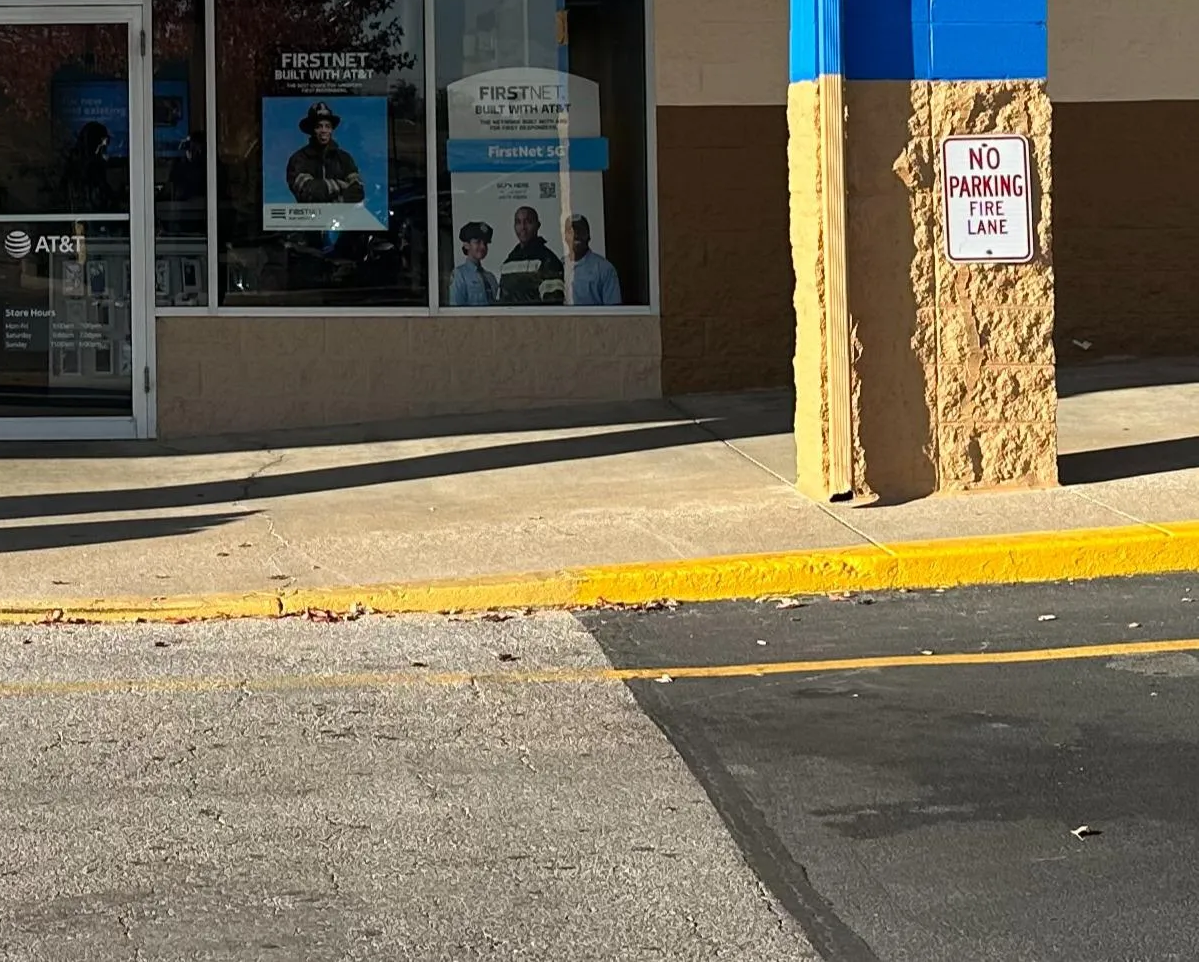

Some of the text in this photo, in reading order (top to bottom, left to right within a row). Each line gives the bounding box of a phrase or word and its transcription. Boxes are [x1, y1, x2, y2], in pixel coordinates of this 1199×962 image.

[282, 52, 369, 68] FIRSTNET
[274, 69, 374, 80] BUILT WITH AT&T
[480, 85, 563, 100] FIRSTNET
[475, 104, 571, 115] BUILT WITH AT&T
[488, 146, 566, 158] FirstNet 5G
[969, 147, 1000, 170] NO
[949, 174, 1023, 198] PARKING
[970, 200, 1005, 216] FIRE
[968, 219, 1009, 235] LANE
[35, 235, 86, 253] AT&T
[5, 309, 56, 317] Store Hours
